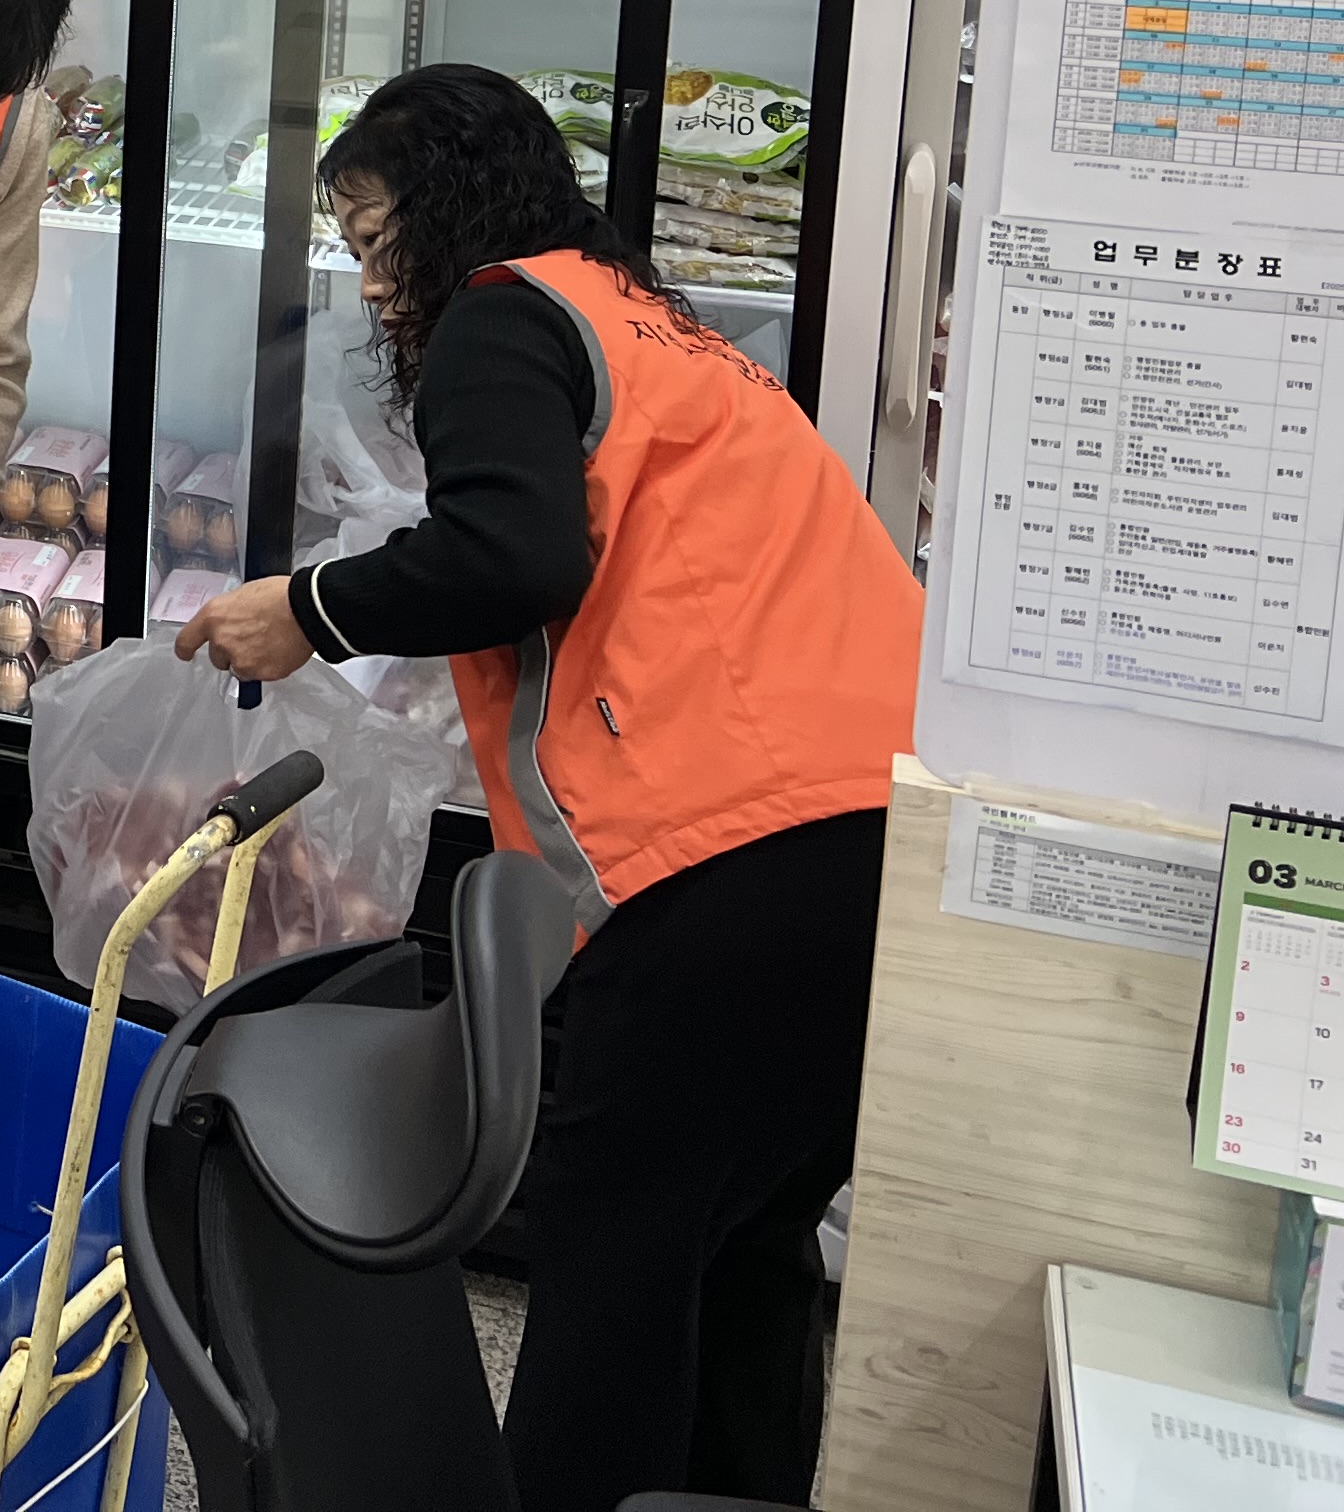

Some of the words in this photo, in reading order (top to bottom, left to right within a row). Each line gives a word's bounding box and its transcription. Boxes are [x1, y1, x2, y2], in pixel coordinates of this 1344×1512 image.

[1248, 859, 1298, 889] 03
[1240, 960, 1250, 971] 2
[1320, 975, 1330, 986] 3
[1235, 1011, 1245, 1022] 9
[1315, 1026, 1331, 1039] 10
[1230, 1062, 1245, 1074] 16
[1309, 1079, 1324, 1090] 17
[1224, 1114, 1243, 1127] 23
[1303, 1131, 1322, 1144] 24
[1222, 1141, 1241, 1154] 30
[1301, 1158, 1317, 1171] 31
